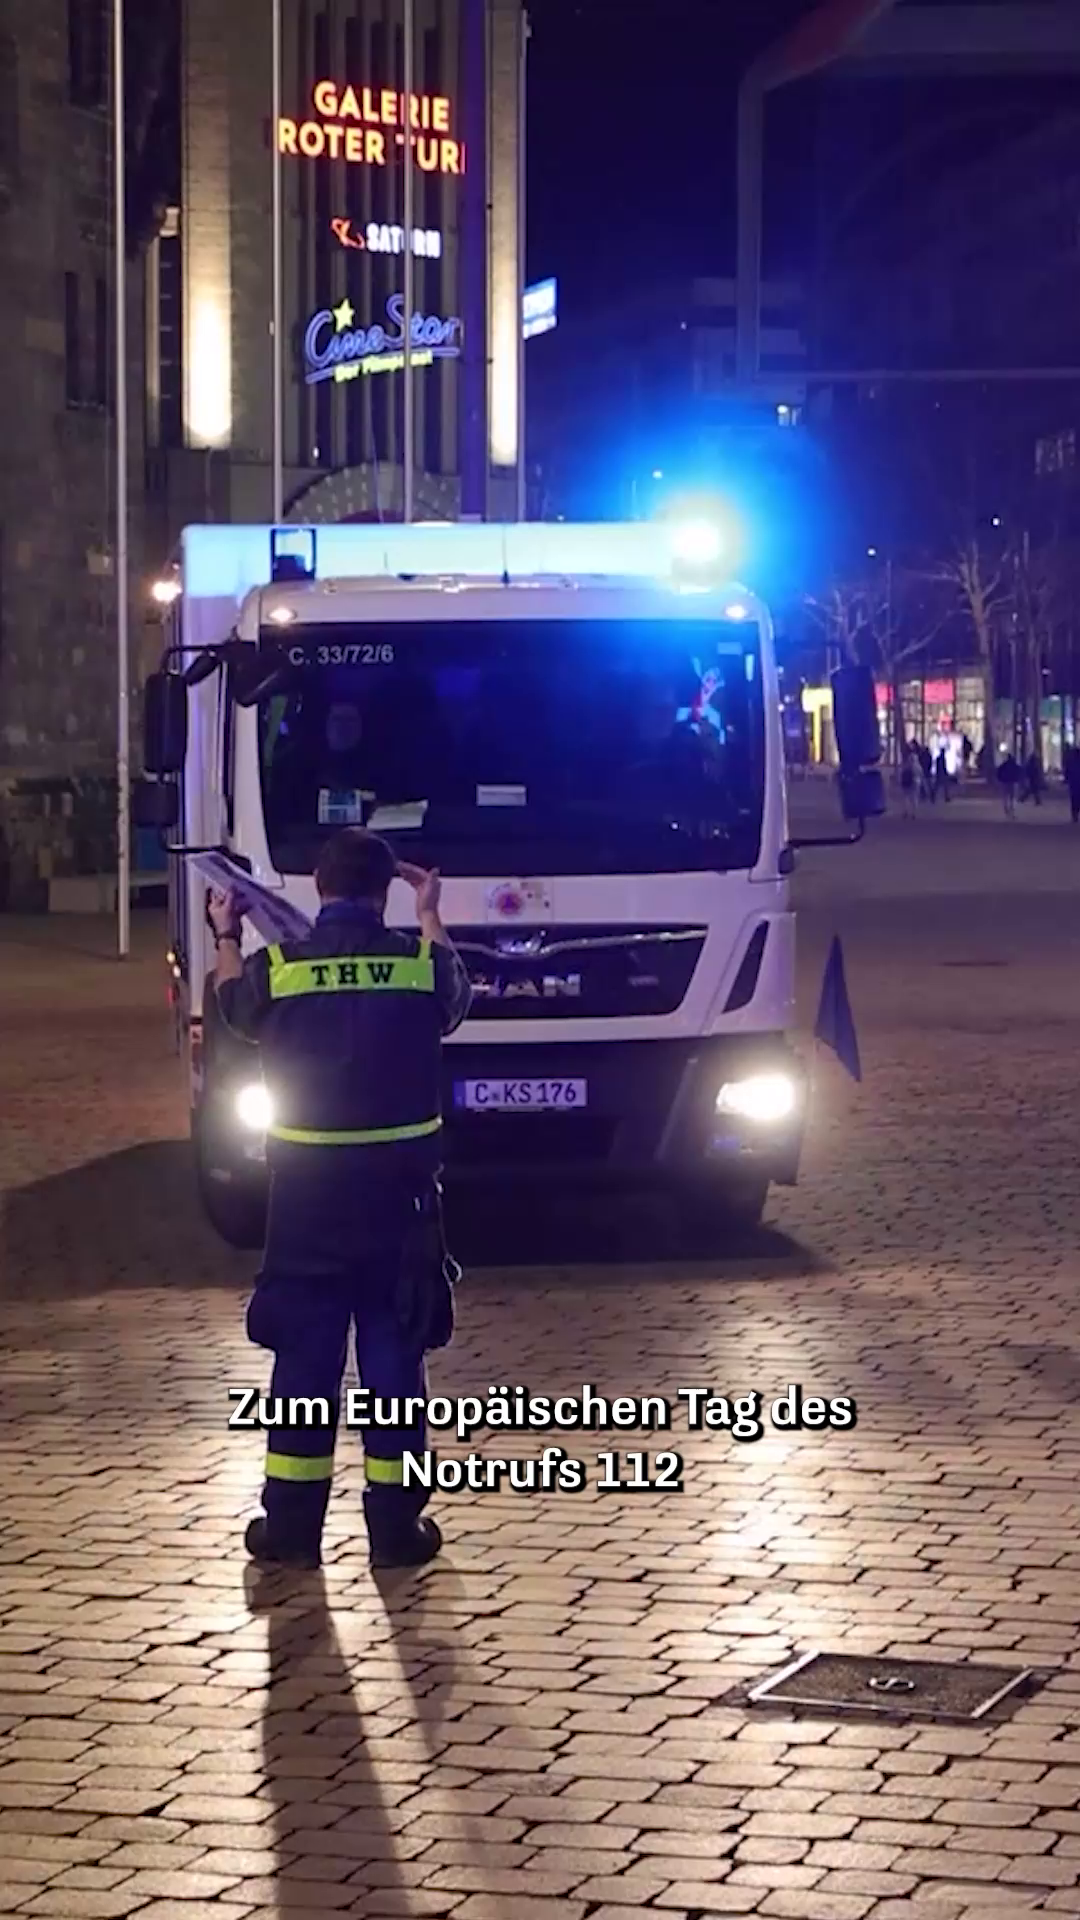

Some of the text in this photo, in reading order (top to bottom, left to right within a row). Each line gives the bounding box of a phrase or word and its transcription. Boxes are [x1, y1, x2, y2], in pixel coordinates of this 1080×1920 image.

[313, 80, 450, 132] GALERIE
[277, 117, 386, 166] ROTER
[289, 644, 395, 666] C. 33/72/6
[311, 962, 395, 986] THW
[475, 1083, 488, 1103] C
